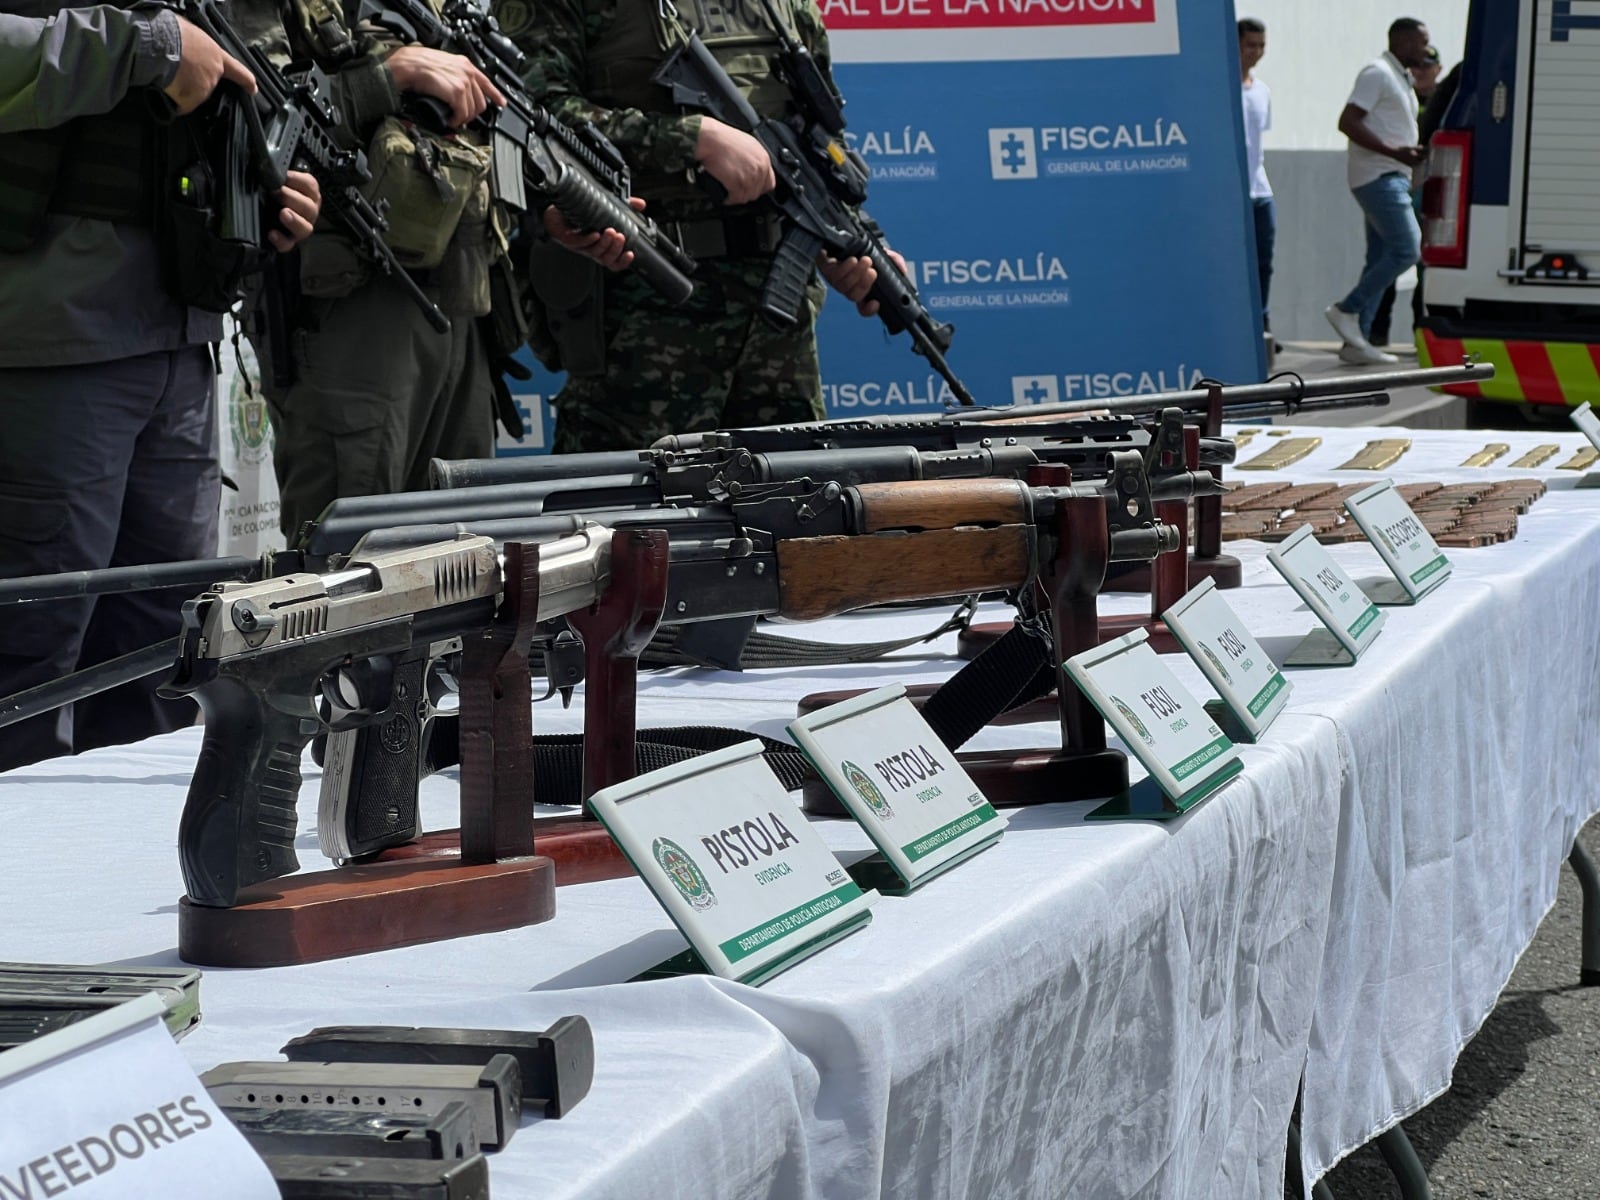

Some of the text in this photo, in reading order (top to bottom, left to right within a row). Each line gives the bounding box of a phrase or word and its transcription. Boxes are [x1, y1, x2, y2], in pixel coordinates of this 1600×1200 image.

[843, 125, 936, 155] CALÍA
[1041, 118, 1188, 152] FISCALÍA
[1048, 156, 1187, 174] GENERAL DE LA NACIÓN
[922, 252, 1069, 285] FISCALÍA
[930, 290, 1069, 308] GENERAL DE LA NACIÓN
[1065, 363, 1206, 399] FISCALÍA
[1217, 628, 1247, 661] FUSIL
[1140, 685, 1182, 720] FUSIL
[874, 745, 945, 793] PISTOLA
[702, 812, 800, 874] PISTOLA
[754, 861, 793, 886] EVIDENCIA
[738, 895, 843, 951] DEPARTAMENTO DE POLICÍA ANTIOQUIA
[0, 1096, 212, 1200] VEEDORES
